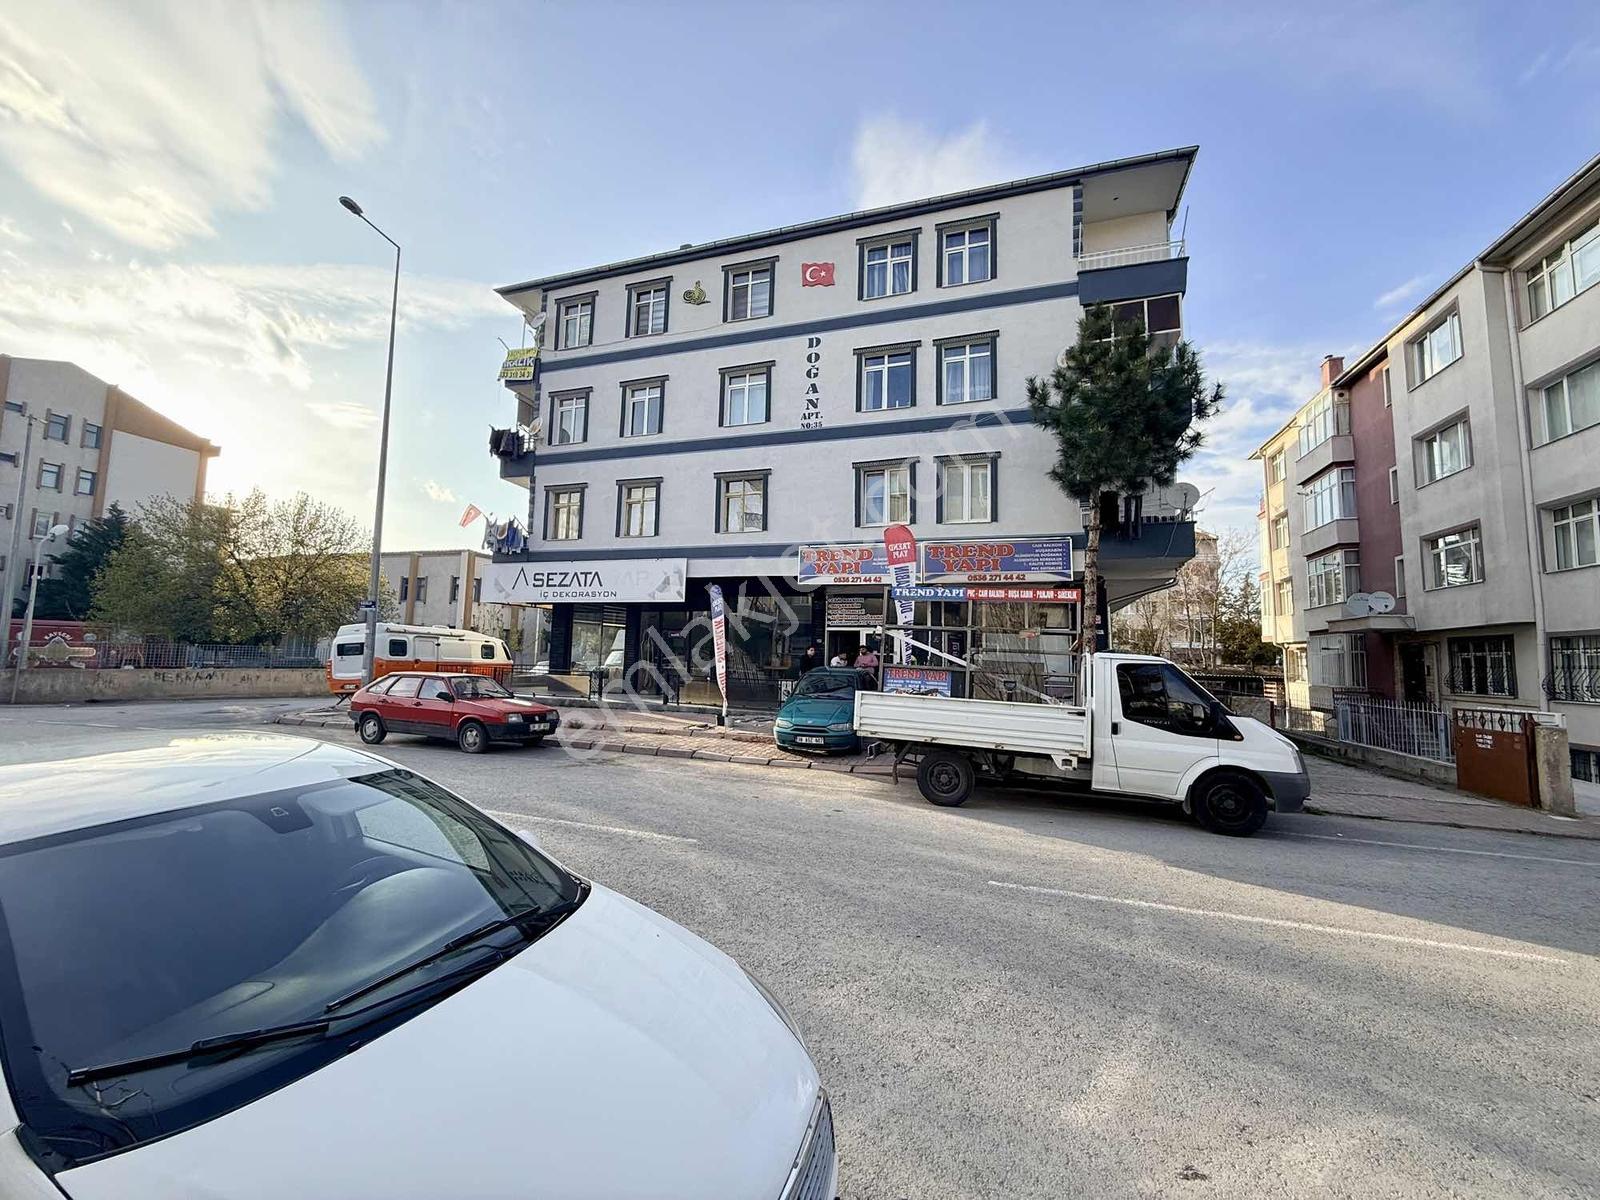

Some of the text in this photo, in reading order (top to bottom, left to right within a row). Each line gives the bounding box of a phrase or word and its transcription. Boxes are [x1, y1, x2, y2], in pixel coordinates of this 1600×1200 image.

[805, 336, 822, 411] DOĞAN
[800, 411, 823, 421] APT.
[802, 548, 873, 561] TREND
[927, 543, 1015, 559] TREND
[814, 560, 862, 574] YAPI
[941, 558, 1002, 572] YAPI
[532, 571, 603, 588] SEZATA
[540, 590, 617, 599] İÇ DEKORASYON
[895, 587, 964, 597] TREND YAPI
[888, 668, 948, 681] TREND YAPI
